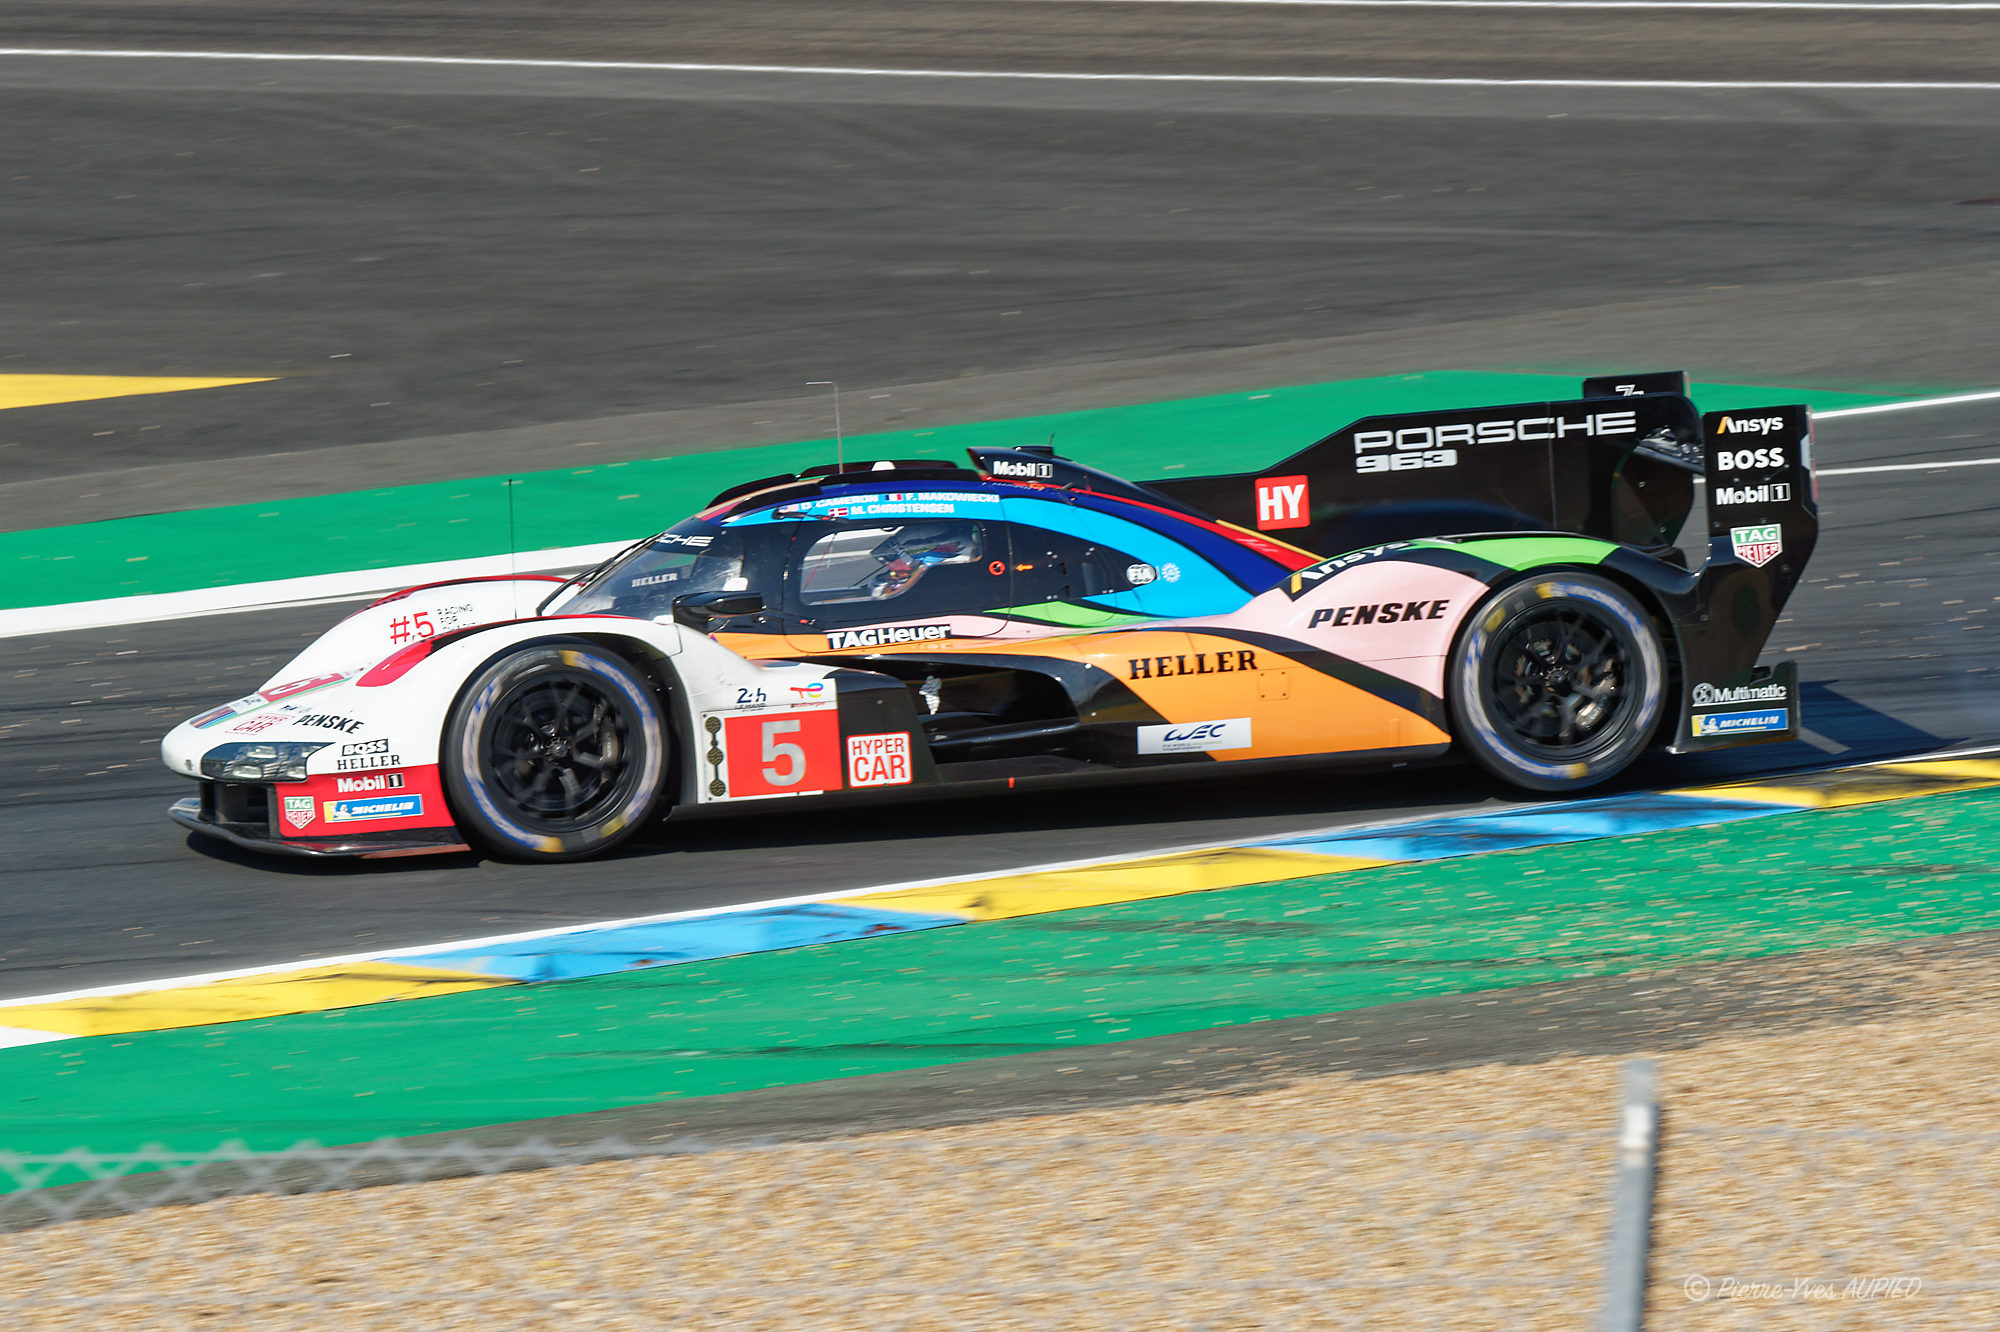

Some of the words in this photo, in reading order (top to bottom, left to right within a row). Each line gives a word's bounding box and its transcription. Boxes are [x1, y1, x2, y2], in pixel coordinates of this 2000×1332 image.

[1353, 411, 1637, 454] PORSCHE
[1716, 416, 1785, 436] Ansys
[1355, 448, 1459, 474] 963
[1717, 447, 1786, 471] BOSS
[993, 461, 1036, 477] Mobil
[1258, 484, 1305, 521] HY
[1715, 485, 1770, 506] Mobil
[867, 503, 955, 514] CHRISTENSEN
[1735, 528, 1777, 543] TAG
[1735, 544, 1780, 563] HEUER
[632, 573, 678, 588] HELLER
[1307, 600, 1450, 629] PENSKE
[389, 611, 435, 644] #5
[1129, 650, 1257, 680] HELLER
[1714, 684, 1787, 702] Multimatic
[292, 714, 365, 735] PENSKE
[1719, 716, 1779, 728] MICHELIN
[1163, 723, 1226, 742] WEC
[343, 740, 387, 755] BOSS
[761, 719, 807, 787] 5
[852, 738, 904, 756] HYPER
[337, 754, 401, 770] HELLER
[854, 755, 905, 782] CAR
[337, 775, 386, 793] Mobil
[286, 799, 312, 809] TAG
[351, 802, 414, 816] MICHELIN
